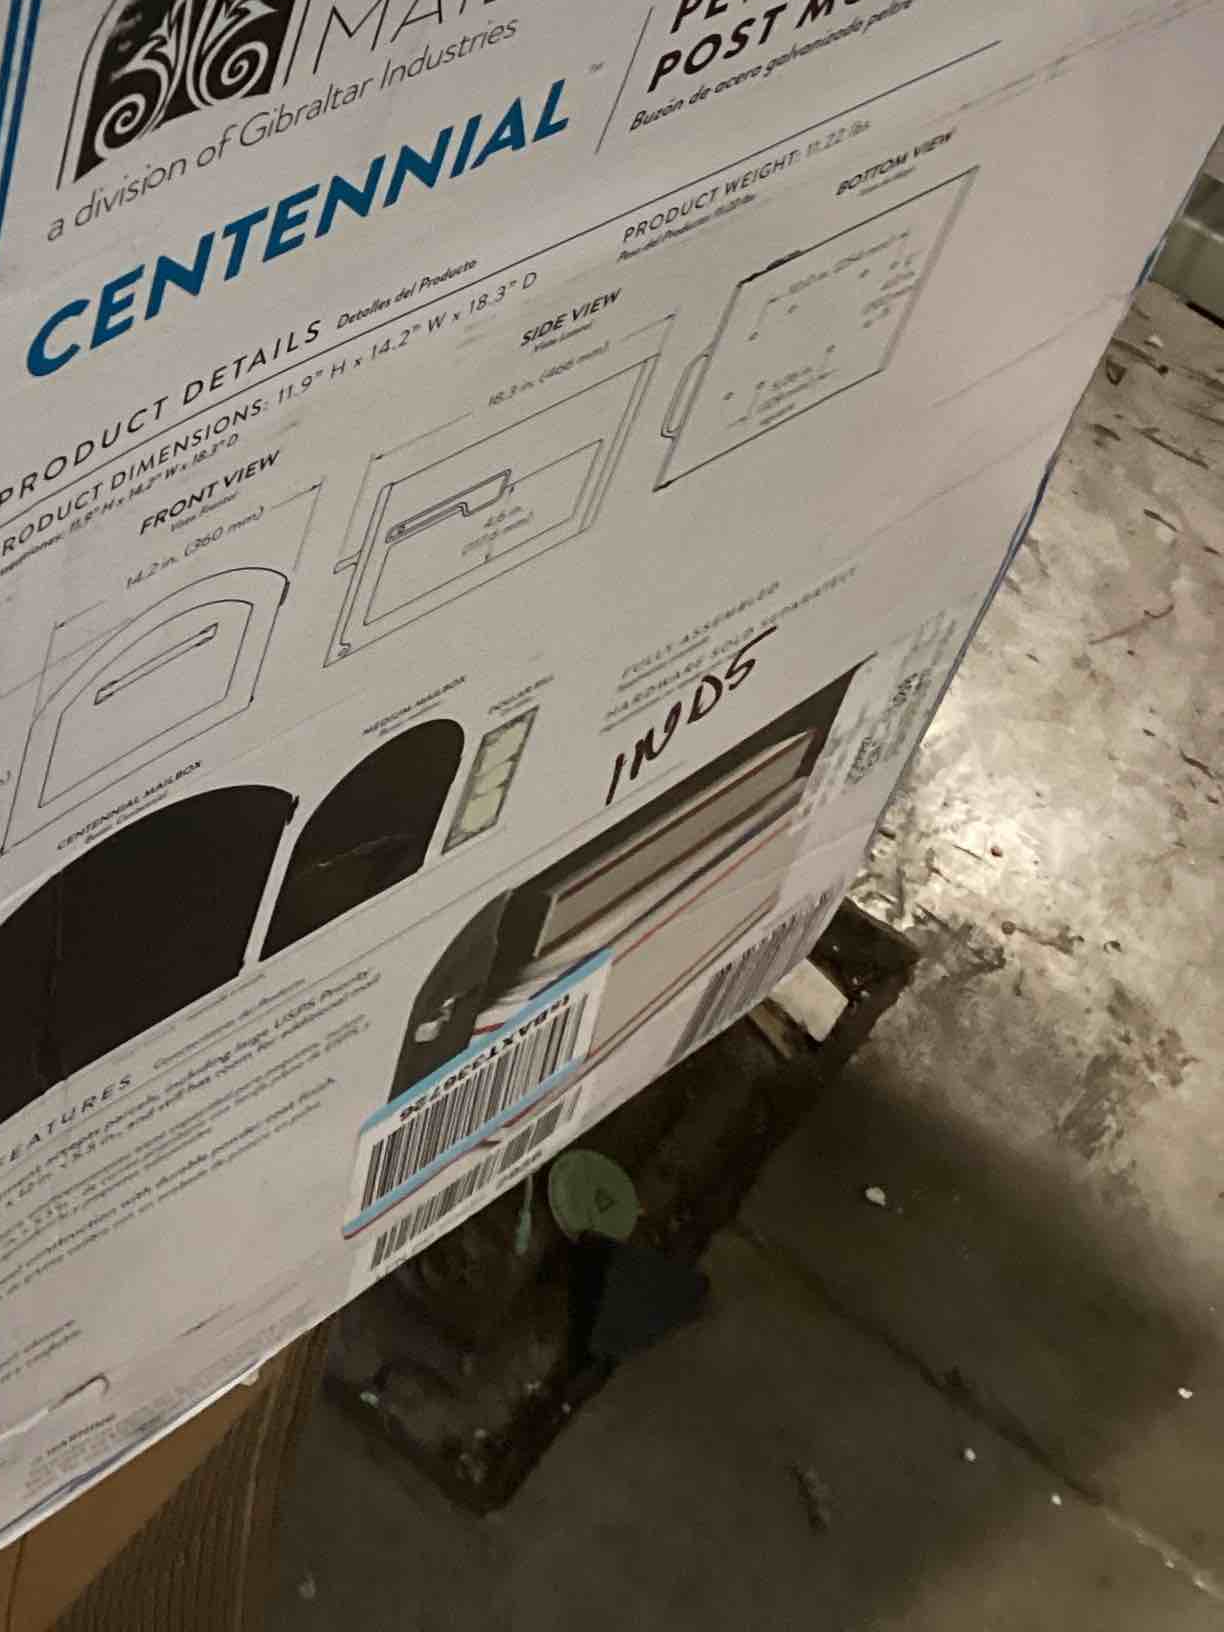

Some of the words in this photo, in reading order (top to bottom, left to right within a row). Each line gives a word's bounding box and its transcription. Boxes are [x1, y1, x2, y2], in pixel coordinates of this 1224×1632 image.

[643, 2, 788, 95] POST
[47, 218, 64, 243] a
[74, 156, 188, 229] division
[196, 124, 234, 169] of
[239, 77, 375, 152] Gibraltar
[379, 17, 520, 89] Industries
[688, 85, 713, 105] de
[622, 185, 720, 243] PRODUCT
[835, 151, 909, 196] BOTTOM
[26, 78, 569, 378] CENTENNIAL
[520, 312, 568, 348] SIDE
[571, 287, 624, 323] VIEW
[109, 398, 273, 493] DIMENSIONS:
[330, 358, 347, 379] H
[427, 314, 448, 334] W
[522, 271, 538, 291] D
[182, 319, 323, 406] DETAILS
[139, 481, 219, 536] FRONT
[222, 449, 281, 489] VIEW
